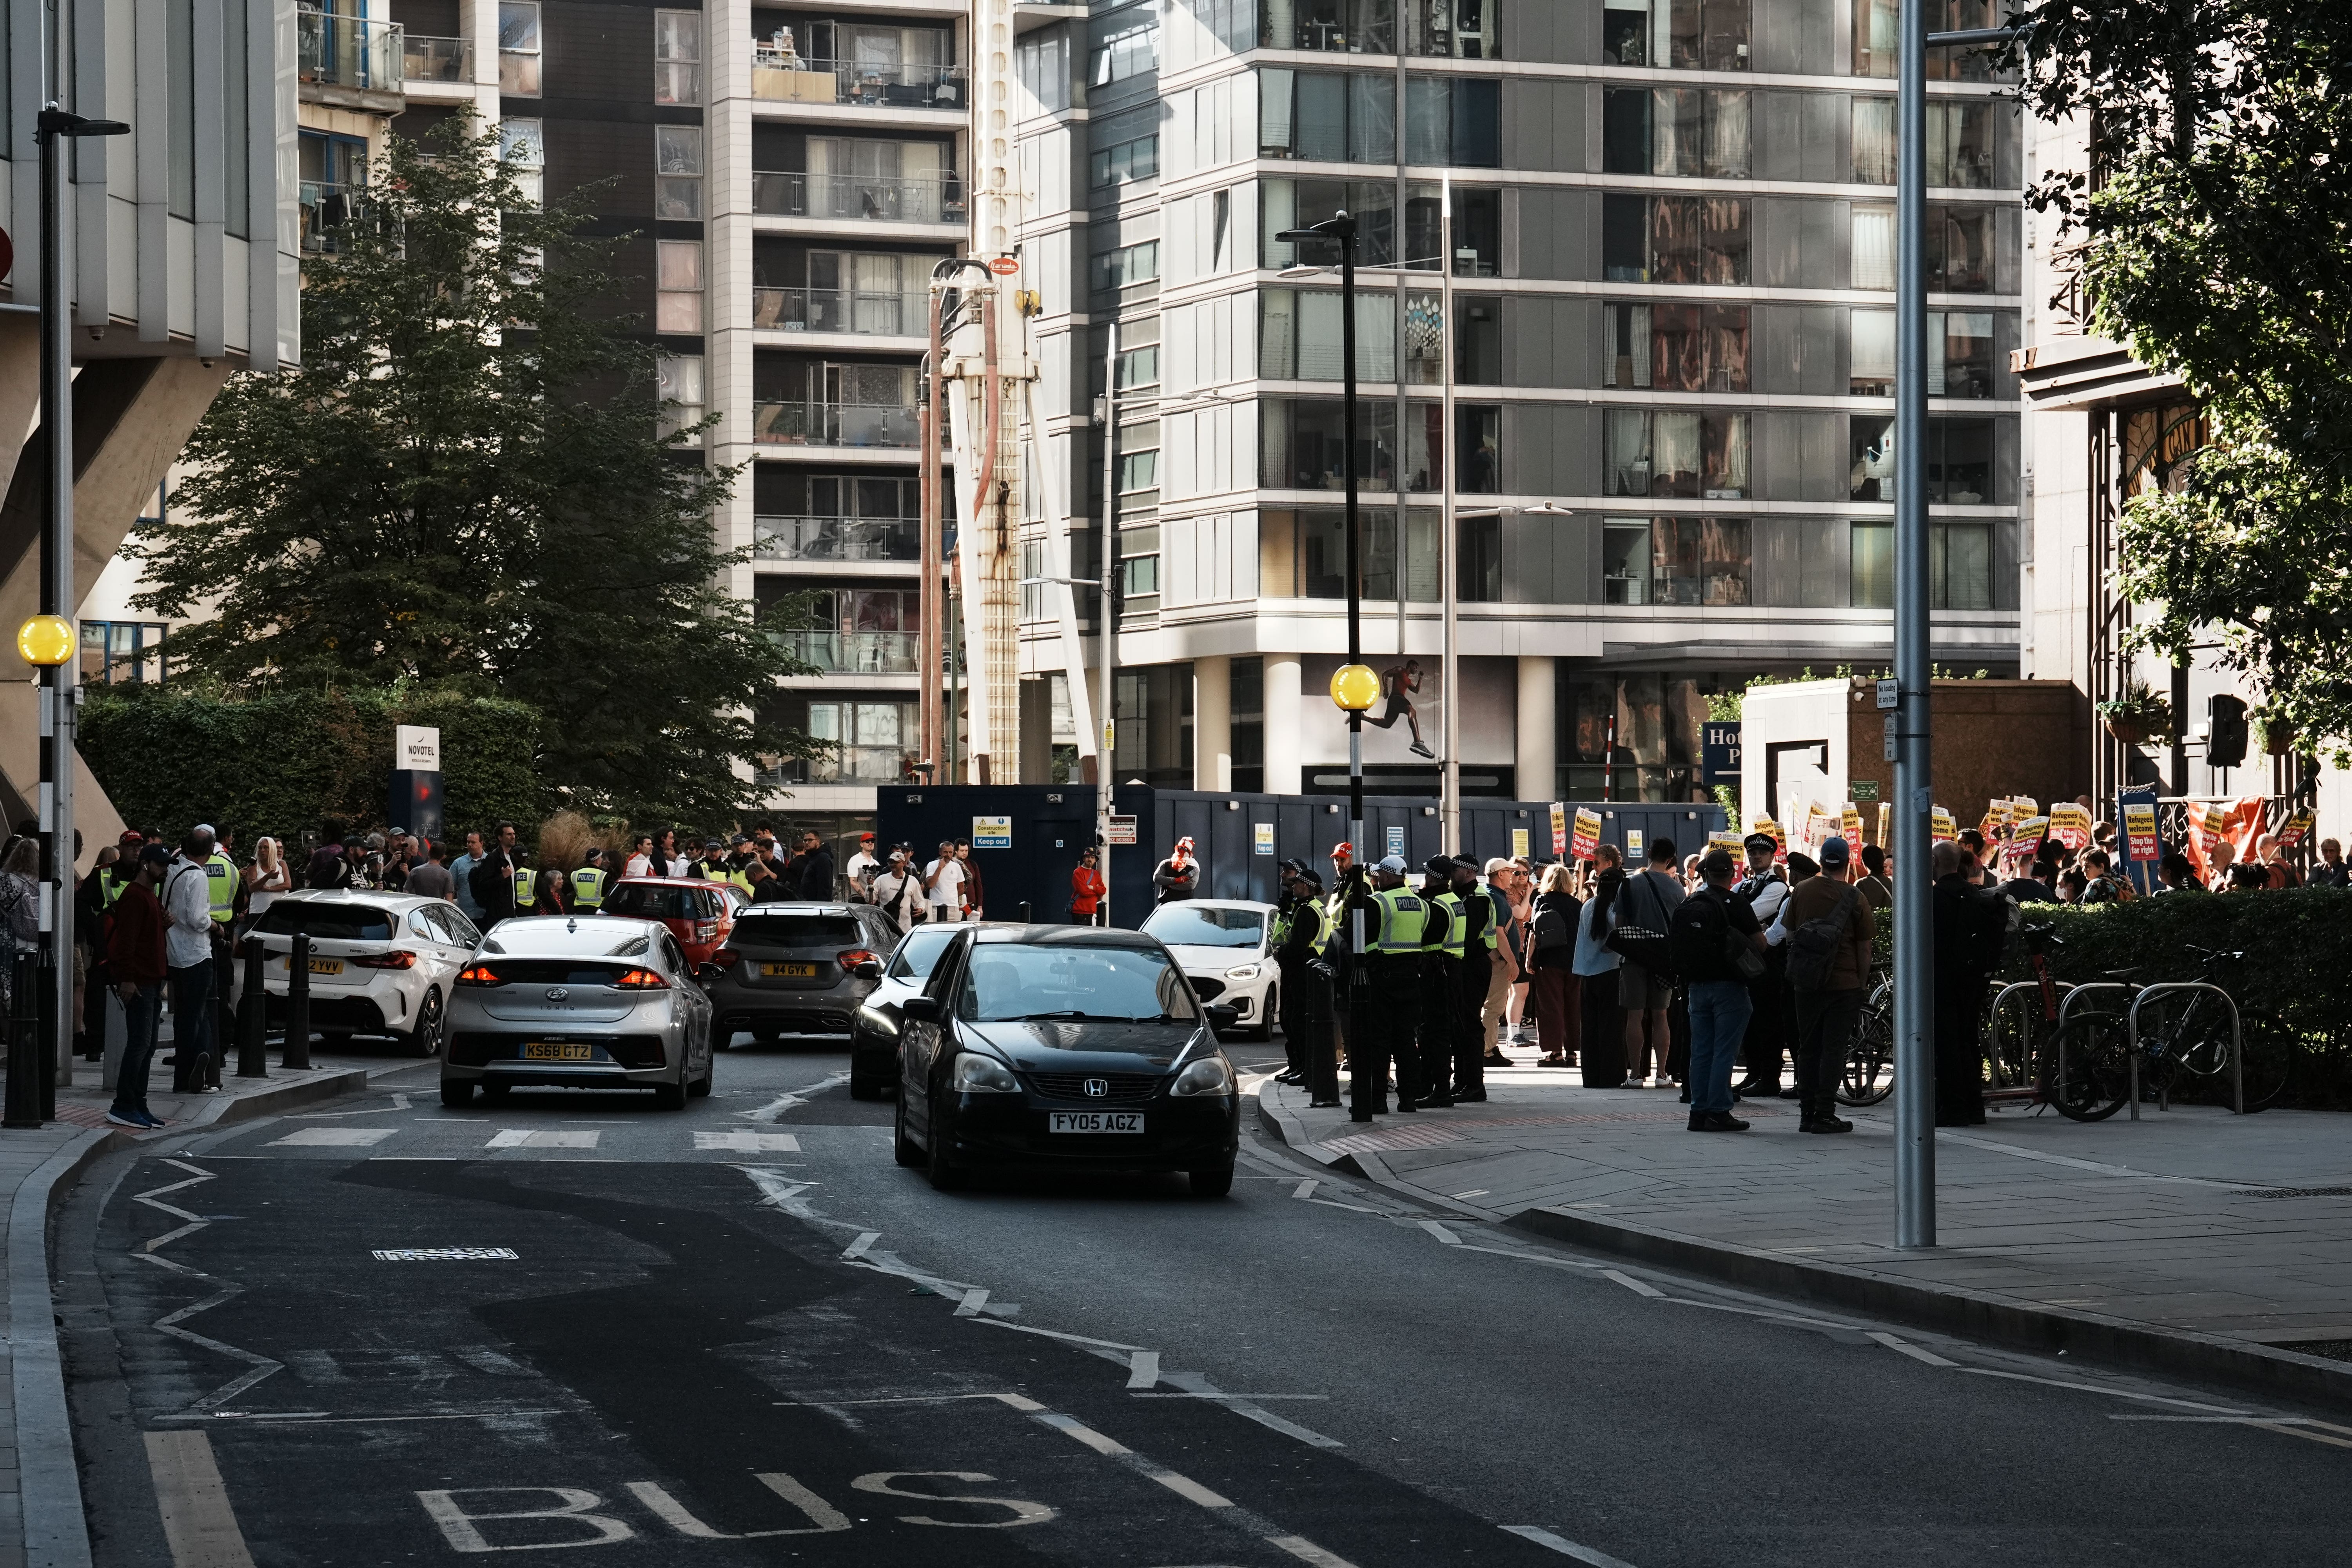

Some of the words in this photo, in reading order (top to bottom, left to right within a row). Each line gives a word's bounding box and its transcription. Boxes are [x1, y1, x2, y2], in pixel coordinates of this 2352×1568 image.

[408, 745, 434, 756] NOVOTEL
[2014, 806, 2036, 815] Refugees
[1576, 817, 1599, 829] Refugees
[2127, 816, 2153, 824] Refugees
[2206, 813, 2222, 824] Refugees
[1576, 825, 1597, 837] welcome
[2018, 824, 2045, 834] Refugees
[2205, 822, 2220, 831] welcome
[1574, 834, 1585, 845] Stop
[2015, 831, 2041, 840] welcome
[1710, 842, 1743, 851] Refugees
[2130, 837, 2143, 846] Stop
[2141, 846, 2154, 855] right
[202, 866, 224, 875] OLICE
[1397, 899, 1421, 909] POLICE
[319, 960, 339, 971] YVV
[788, 965, 808, 975] GYK
[527, 1045, 560, 1056] KS68
[564, 1045, 588, 1057] GTZ
[1057, 1114, 1100, 1130] FY05
[1105, 1115, 1137, 1130] AGZ
[414, 1471, 1054, 1552] BUS
